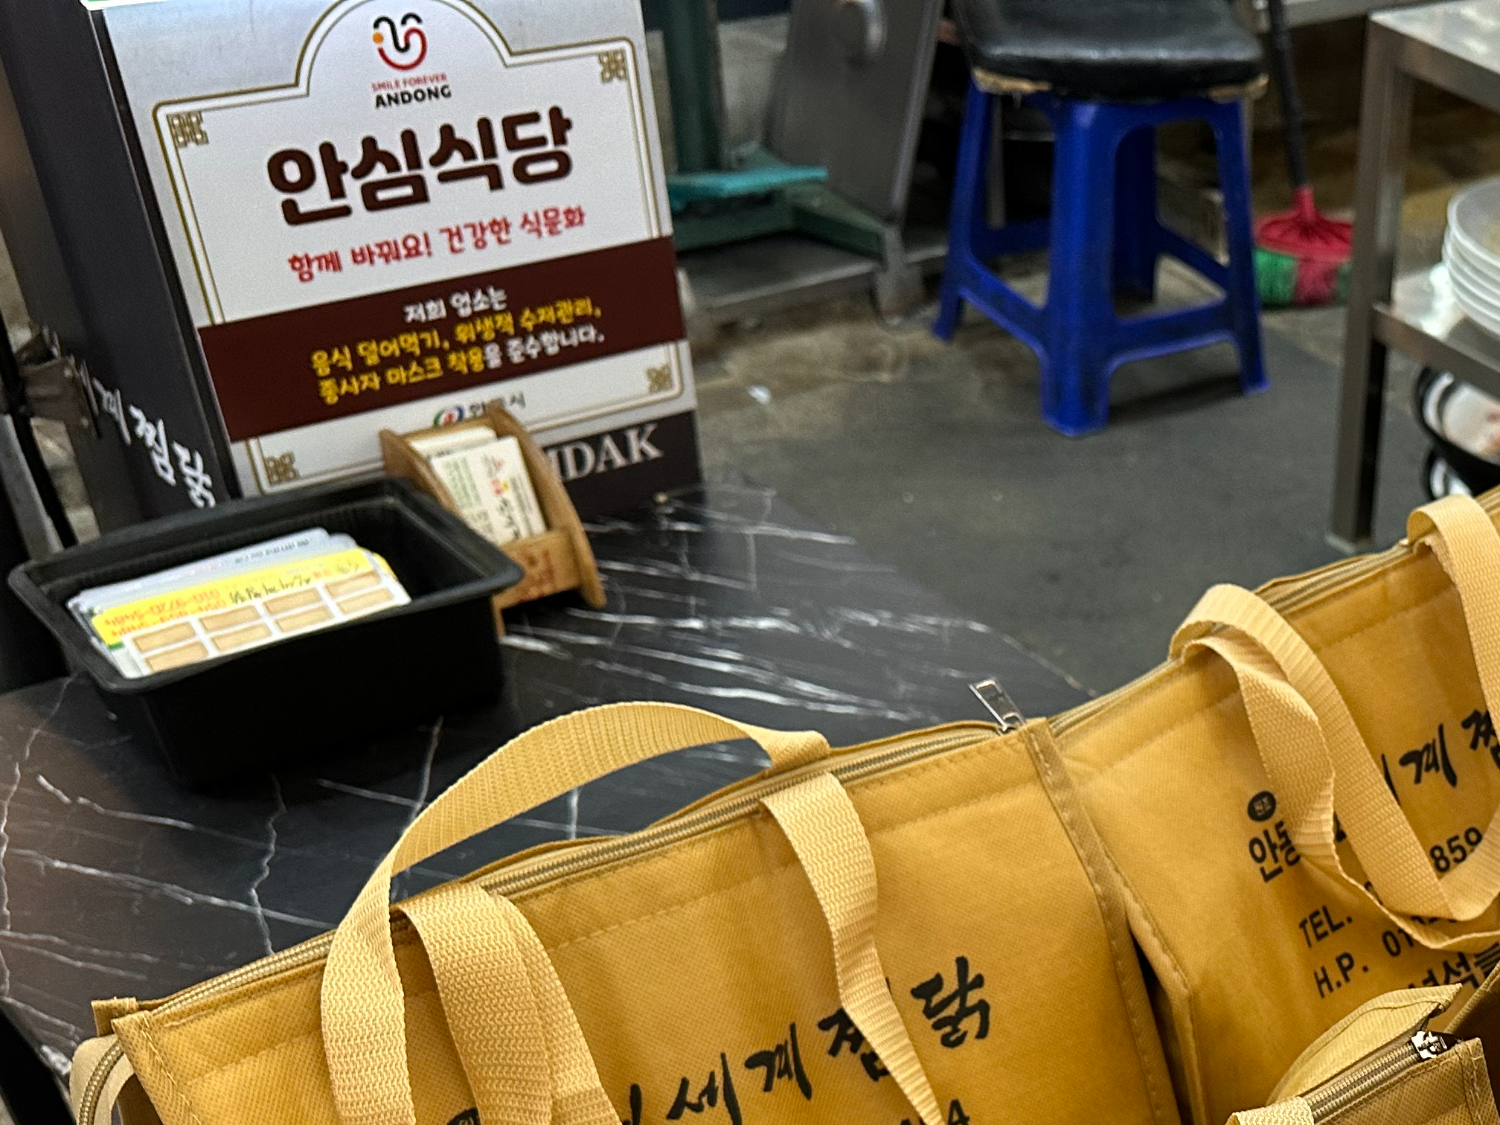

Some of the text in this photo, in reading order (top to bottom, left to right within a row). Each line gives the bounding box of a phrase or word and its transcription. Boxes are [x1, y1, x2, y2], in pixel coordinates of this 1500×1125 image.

[374, 84, 451, 108] ANDONG
[268, 108, 571, 224] 안심식당
[287, 206, 584, 283] 함께 바꿔요! 건강한 식문화
[404, 287, 506, 322] 저희 업소는
[385, 356, 443, 384] 마스크
[1298, 904, 1353, 947] TEL.
[1313, 951, 1368, 998] H.P.
